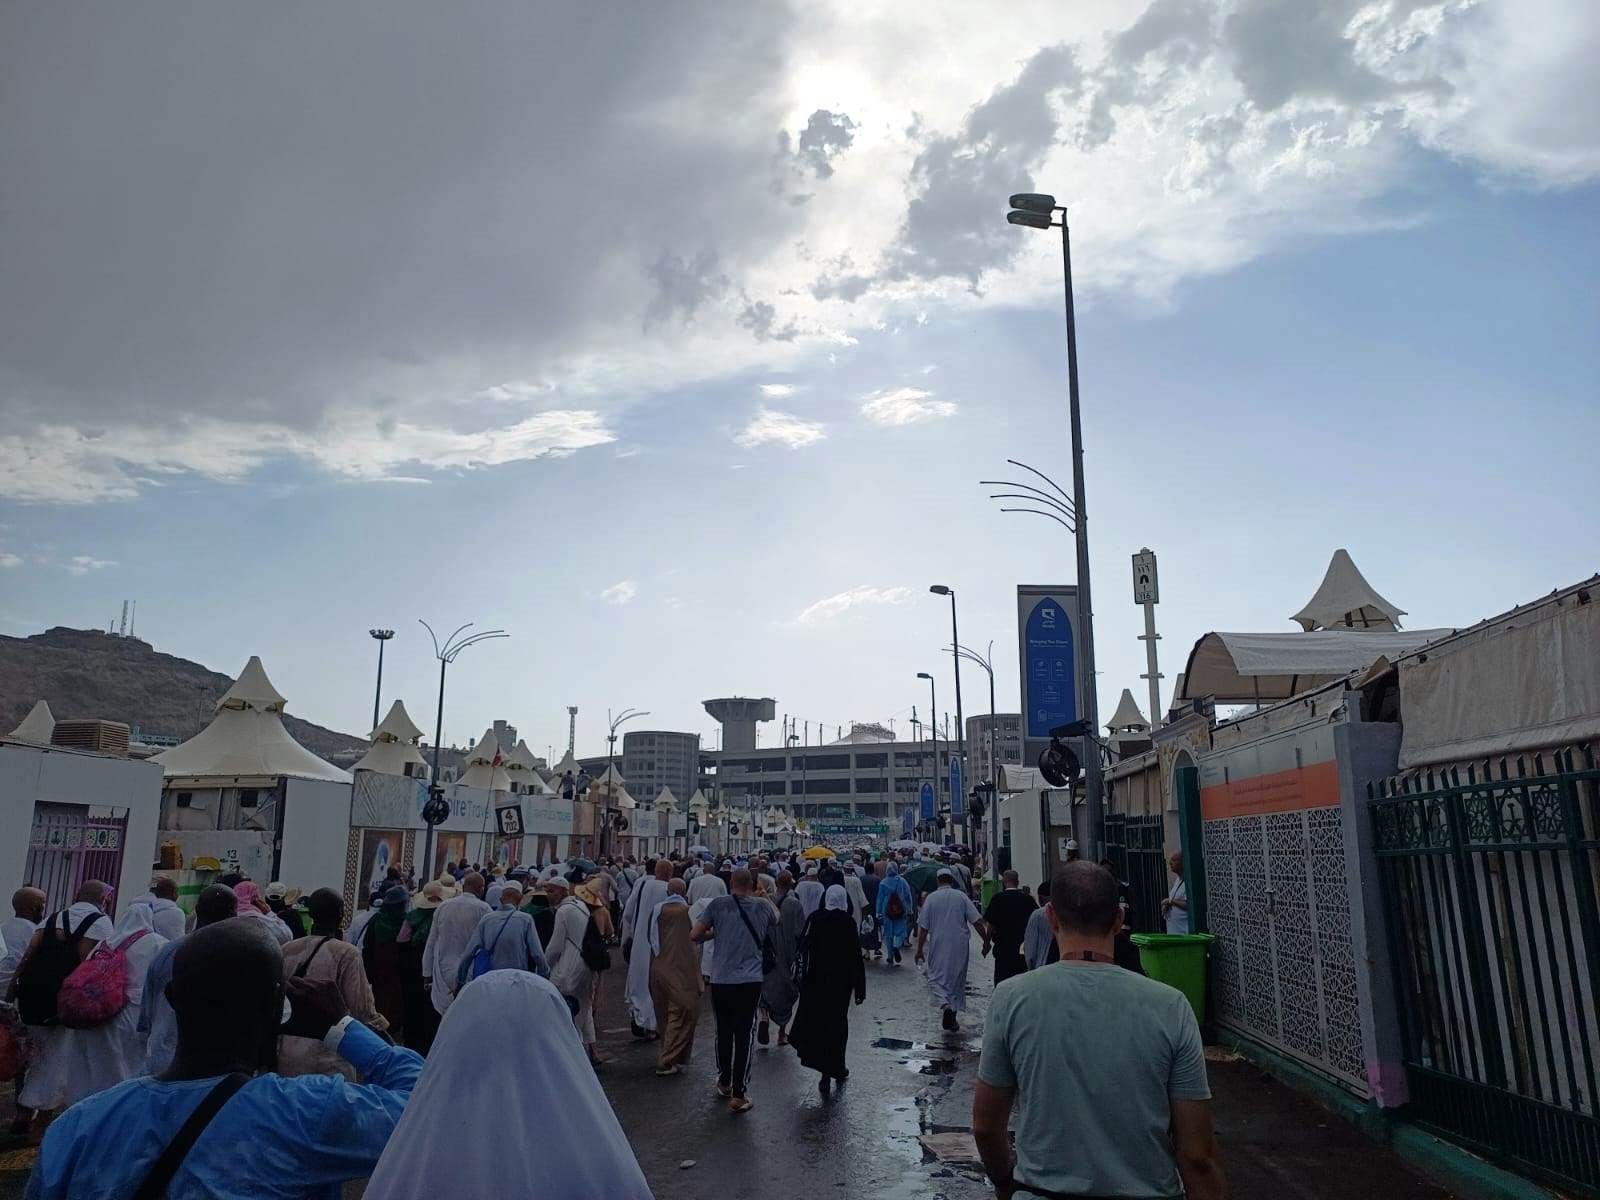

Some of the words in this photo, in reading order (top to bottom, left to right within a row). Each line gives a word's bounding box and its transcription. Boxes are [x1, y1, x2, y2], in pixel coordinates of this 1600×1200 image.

[505, 810, 513, 820] 4
[505, 821, 517, 831] 702
[227, 849, 237, 859] 13
